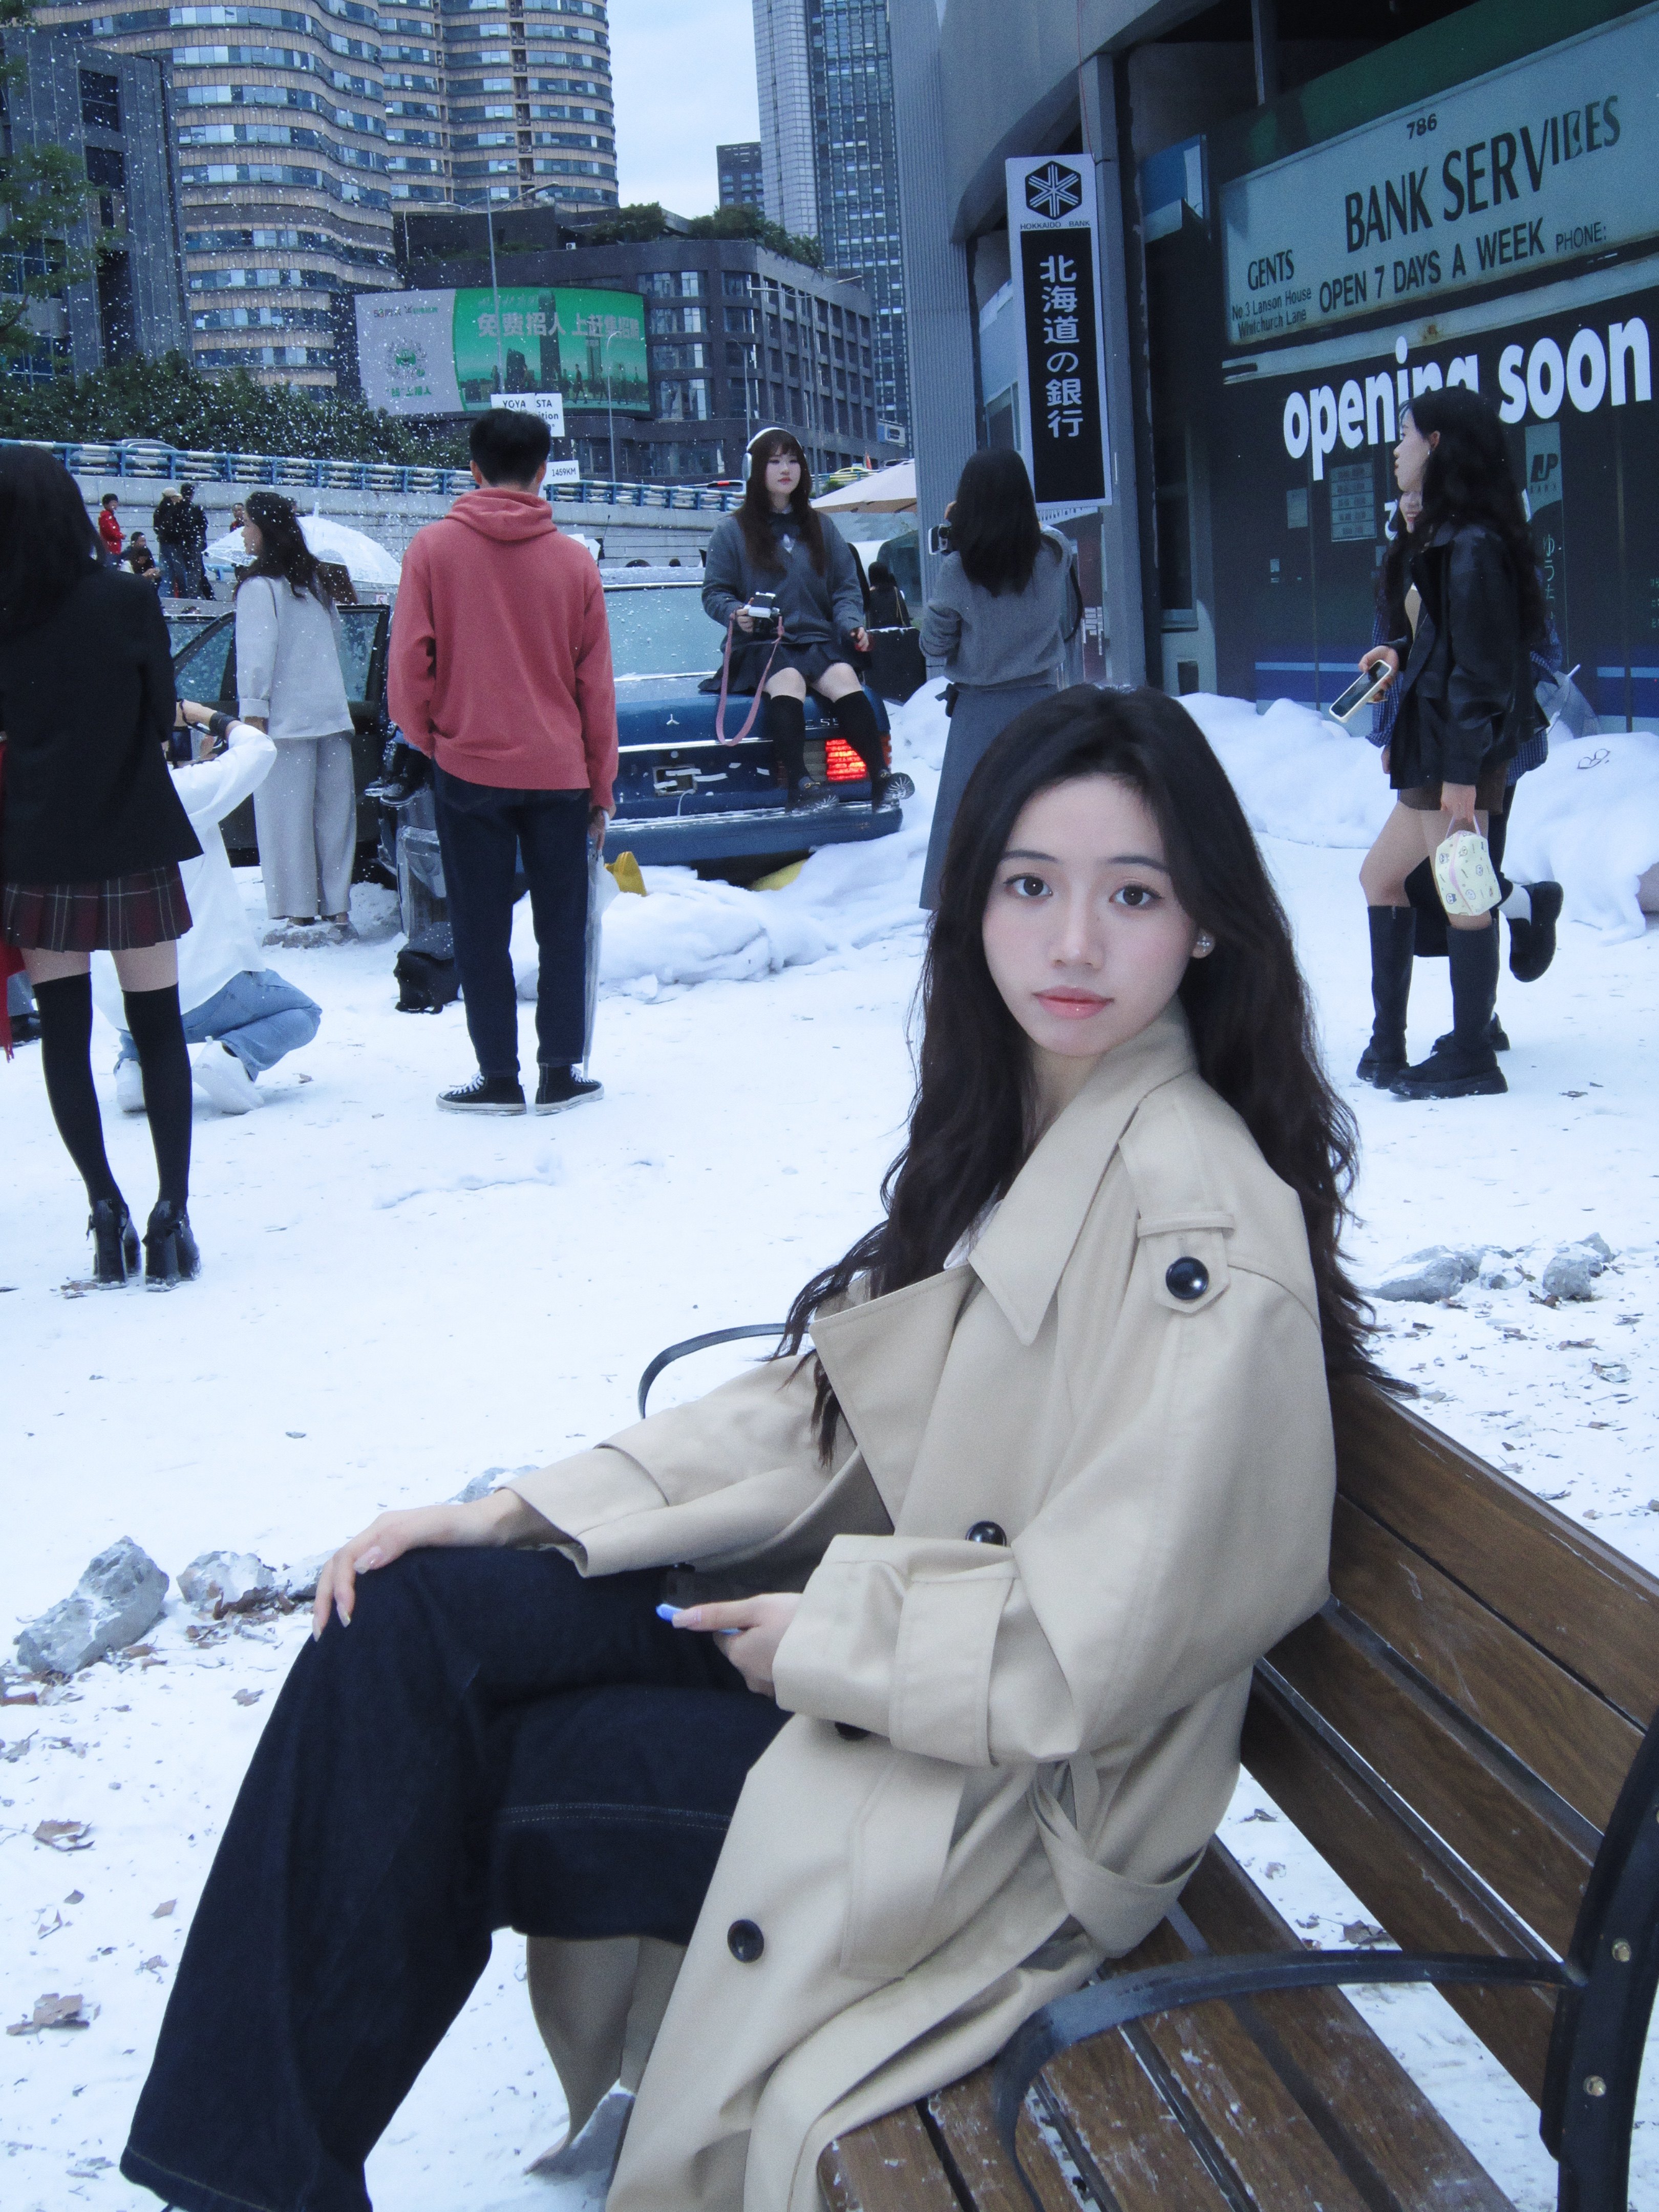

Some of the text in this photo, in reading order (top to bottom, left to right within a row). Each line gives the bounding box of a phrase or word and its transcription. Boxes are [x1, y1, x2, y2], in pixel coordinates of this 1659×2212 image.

[1407, 113, 1437, 140] 786
[1020, 221, 1061, 229] HOKKAIDO
[1345, 166, 1433, 253] BANK
[1247, 249, 1294, 291] GENTS
[1320, 216, 1606, 313] OPEN 7 DAYS A WEEK PHONE:
[1285, 287, 1312, 306] House
[1286, 308, 1307, 326] Lane
[1039, 254, 1083, 438] 北海道の銀行
[1498, 317, 1652, 423] soon
[536, 399, 553, 408] STA
